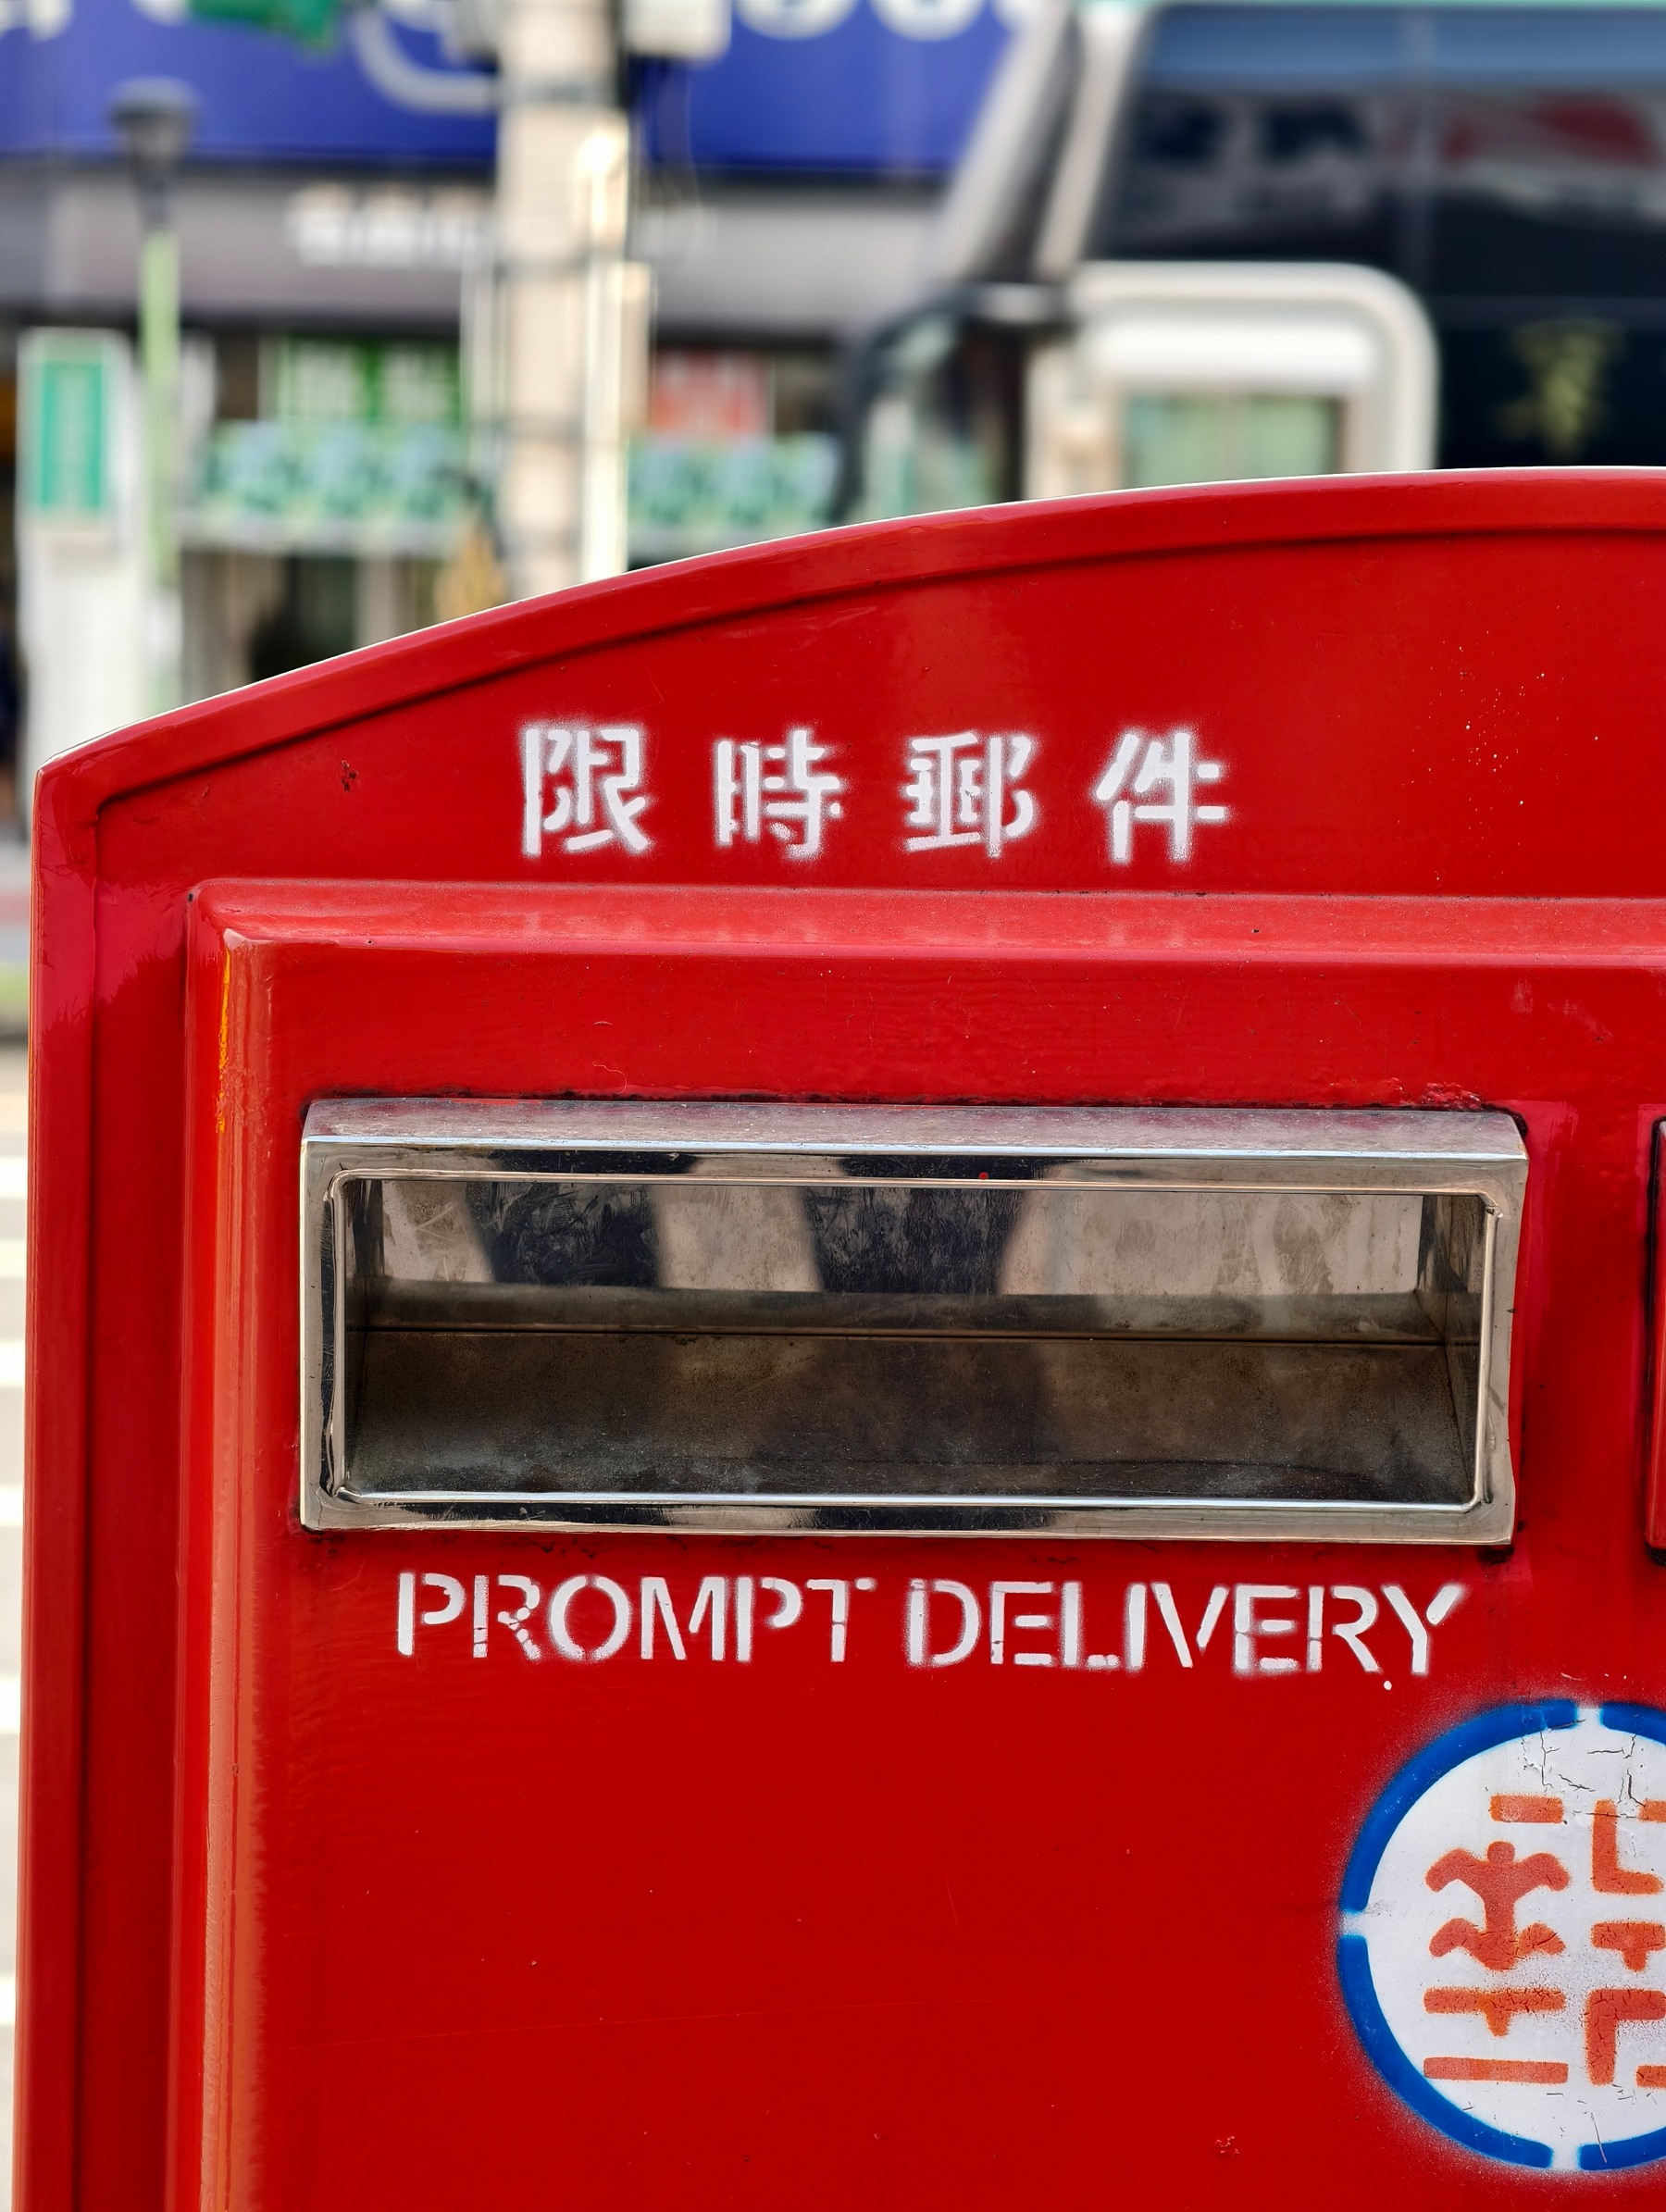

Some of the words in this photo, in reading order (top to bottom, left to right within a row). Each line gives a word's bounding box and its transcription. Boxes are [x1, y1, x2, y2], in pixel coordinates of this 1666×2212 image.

[521, 724, 1229, 861] 限時郵件
[397, 1572, 877, 1663] PROMPT
[906, 1577, 1465, 1674] DELIVERY
